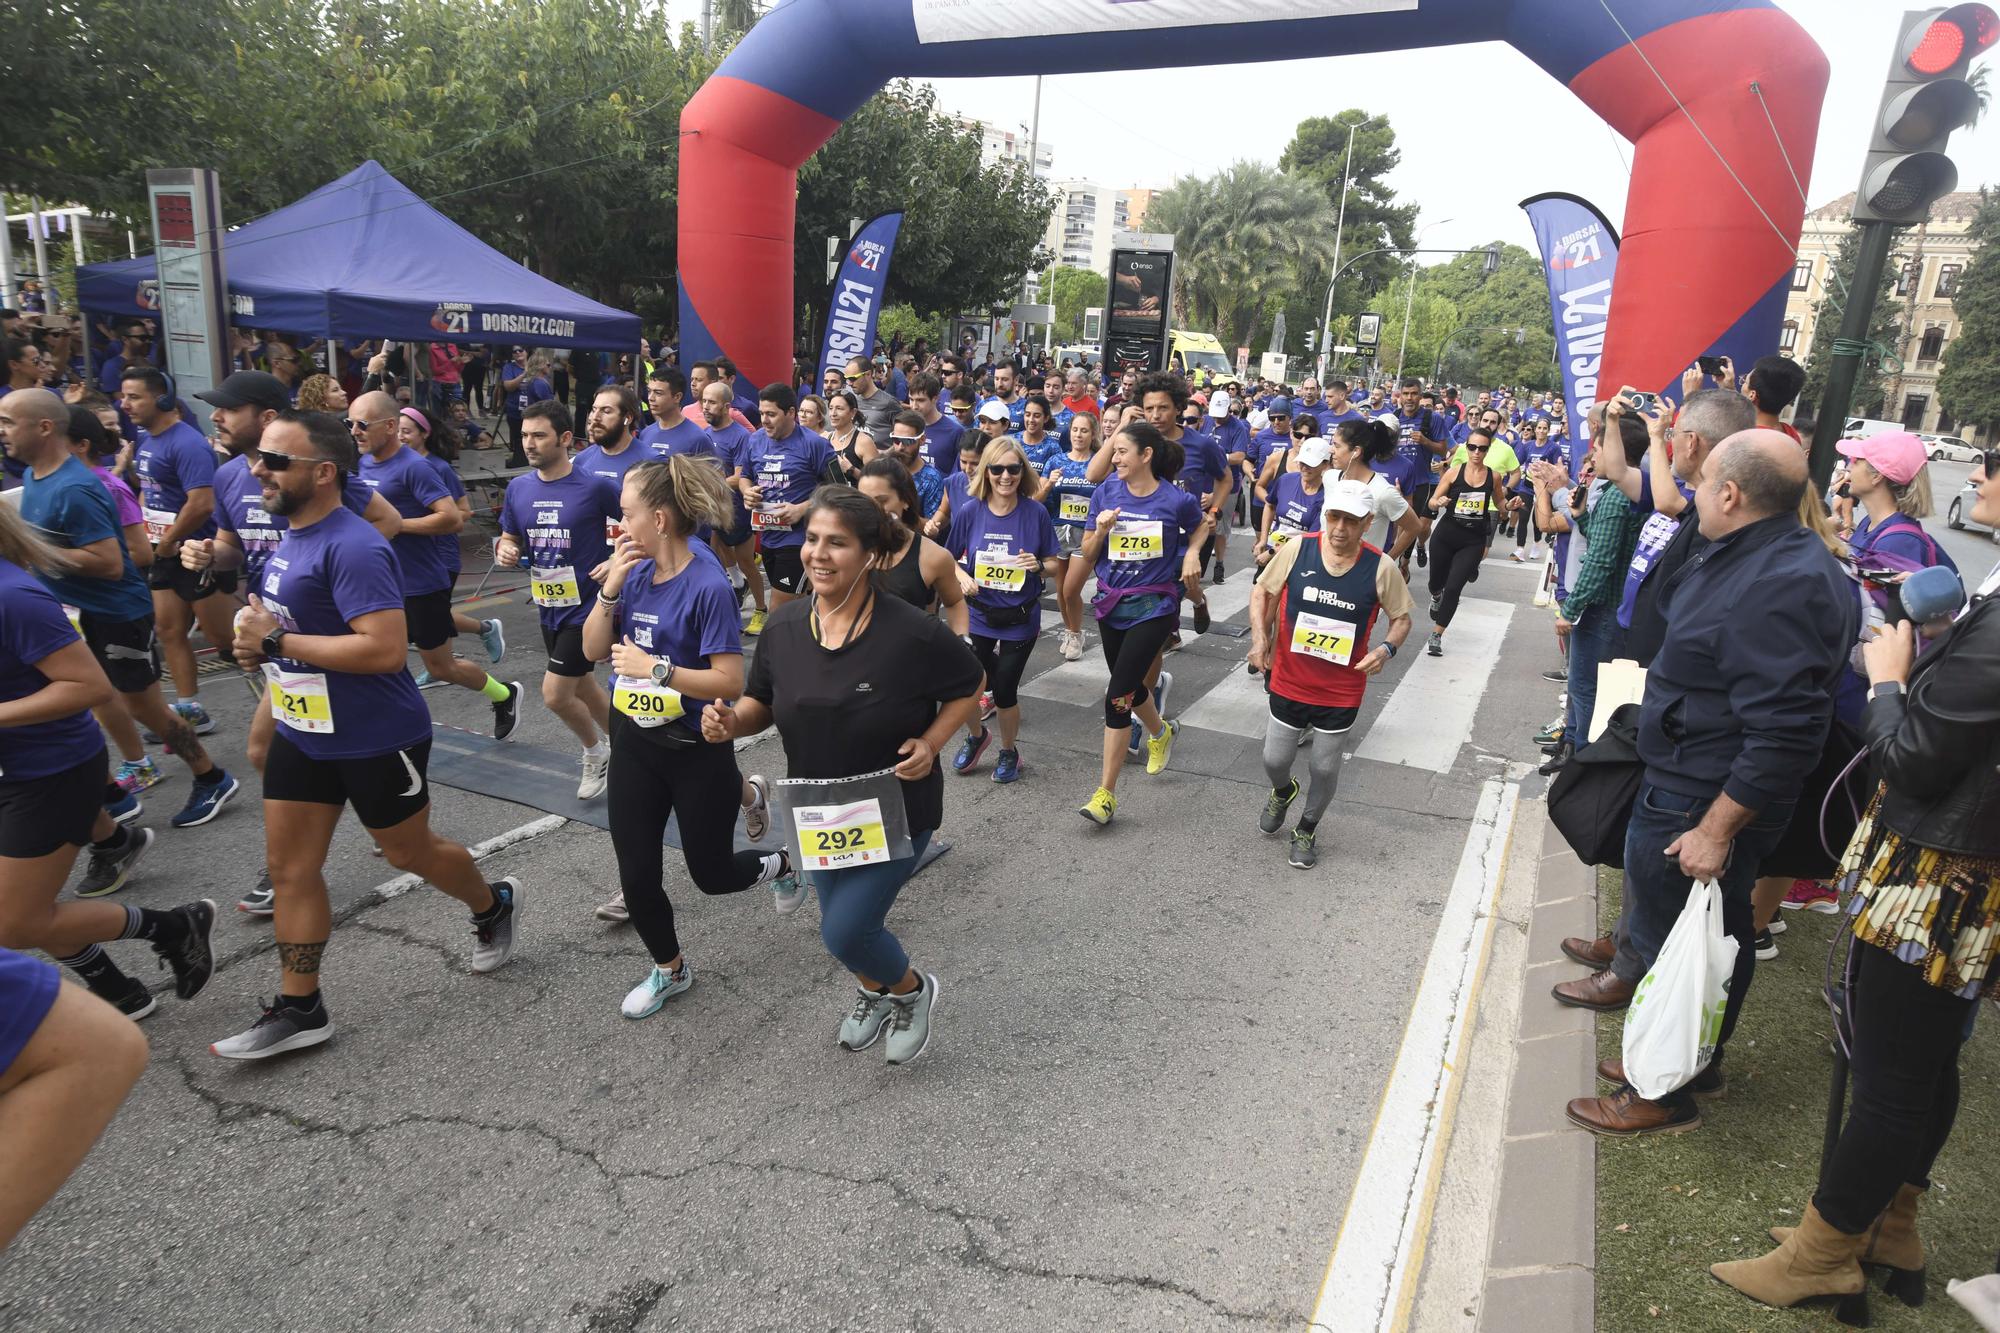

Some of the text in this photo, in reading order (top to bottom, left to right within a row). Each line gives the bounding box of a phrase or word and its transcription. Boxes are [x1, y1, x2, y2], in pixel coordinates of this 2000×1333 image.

[1561, 222, 1602, 248] DORSAL
[1569, 234, 1603, 269] 21
[860, 250, 881, 271] 21
[443, 302, 473, 312] DORSAL
[446, 311, 469, 333] 21
[481, 313, 576, 338] DORSAL21.COM
[824, 278, 874, 373] RSAL21
[1062, 476, 1097, 486] edico
[1068, 504, 1087, 514] 190
[1462, 500, 1480, 508] 233
[1120, 537, 1150, 549] 278
[985, 566, 1014, 580] 207
[539, 583, 565, 596] 183
[1318, 590, 1337, 599] pan
[1319, 597, 1356, 611] moreno
[1306, 632, 1340, 649] 277
[628, 693, 664, 713] 290
[816, 828, 865, 851] 292
